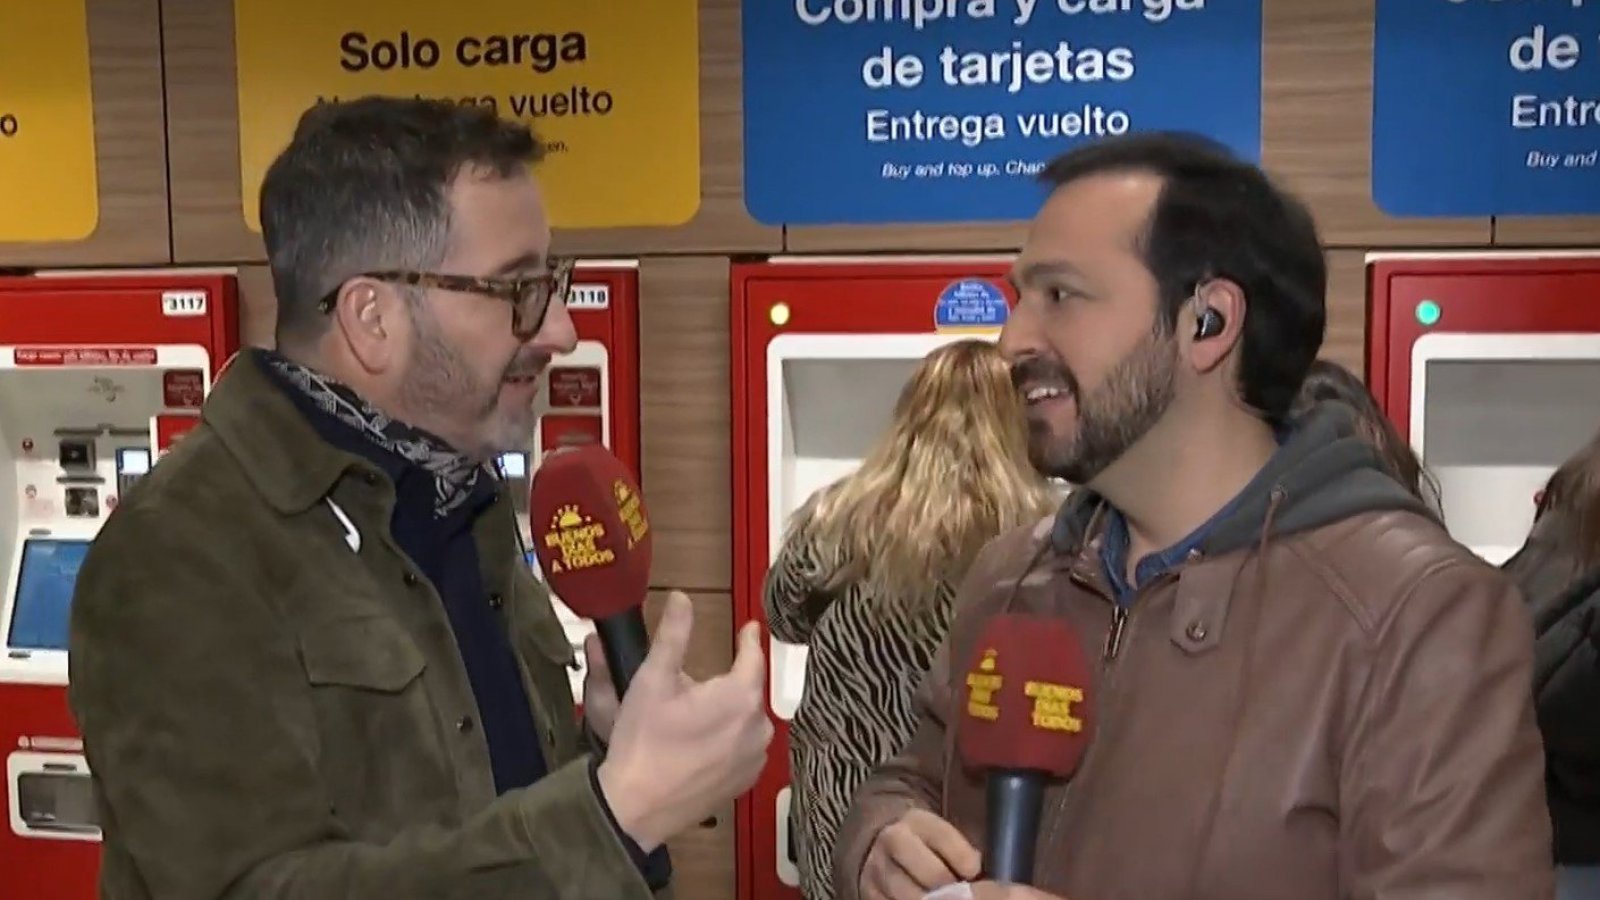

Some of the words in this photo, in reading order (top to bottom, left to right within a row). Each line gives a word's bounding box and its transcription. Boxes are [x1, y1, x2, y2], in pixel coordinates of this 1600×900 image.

[1058, 0, 1206, 22] cag
[339, 31, 441, 71] Solo
[455, 30, 588, 73] carga
[1509, 24, 1580, 71] de
[862, 46, 924, 88] de
[939, 41, 1135, 92] tarjetas
[509, 86, 613, 117] vuelto
[866, 109, 1005, 147] Entrega
[1017, 105, 1130, 137] vuelto
[881, 162, 911, 180] Buy
[914, 162, 944, 178] and
[948, 162, 973, 178] top
[1005, 159, 1047, 176] Chan
[1526, 150, 1559, 170] Buy
[1563, 150, 1598, 168] and
[169, 297, 204, 311] 3117
[552, 559, 563, 573] A
